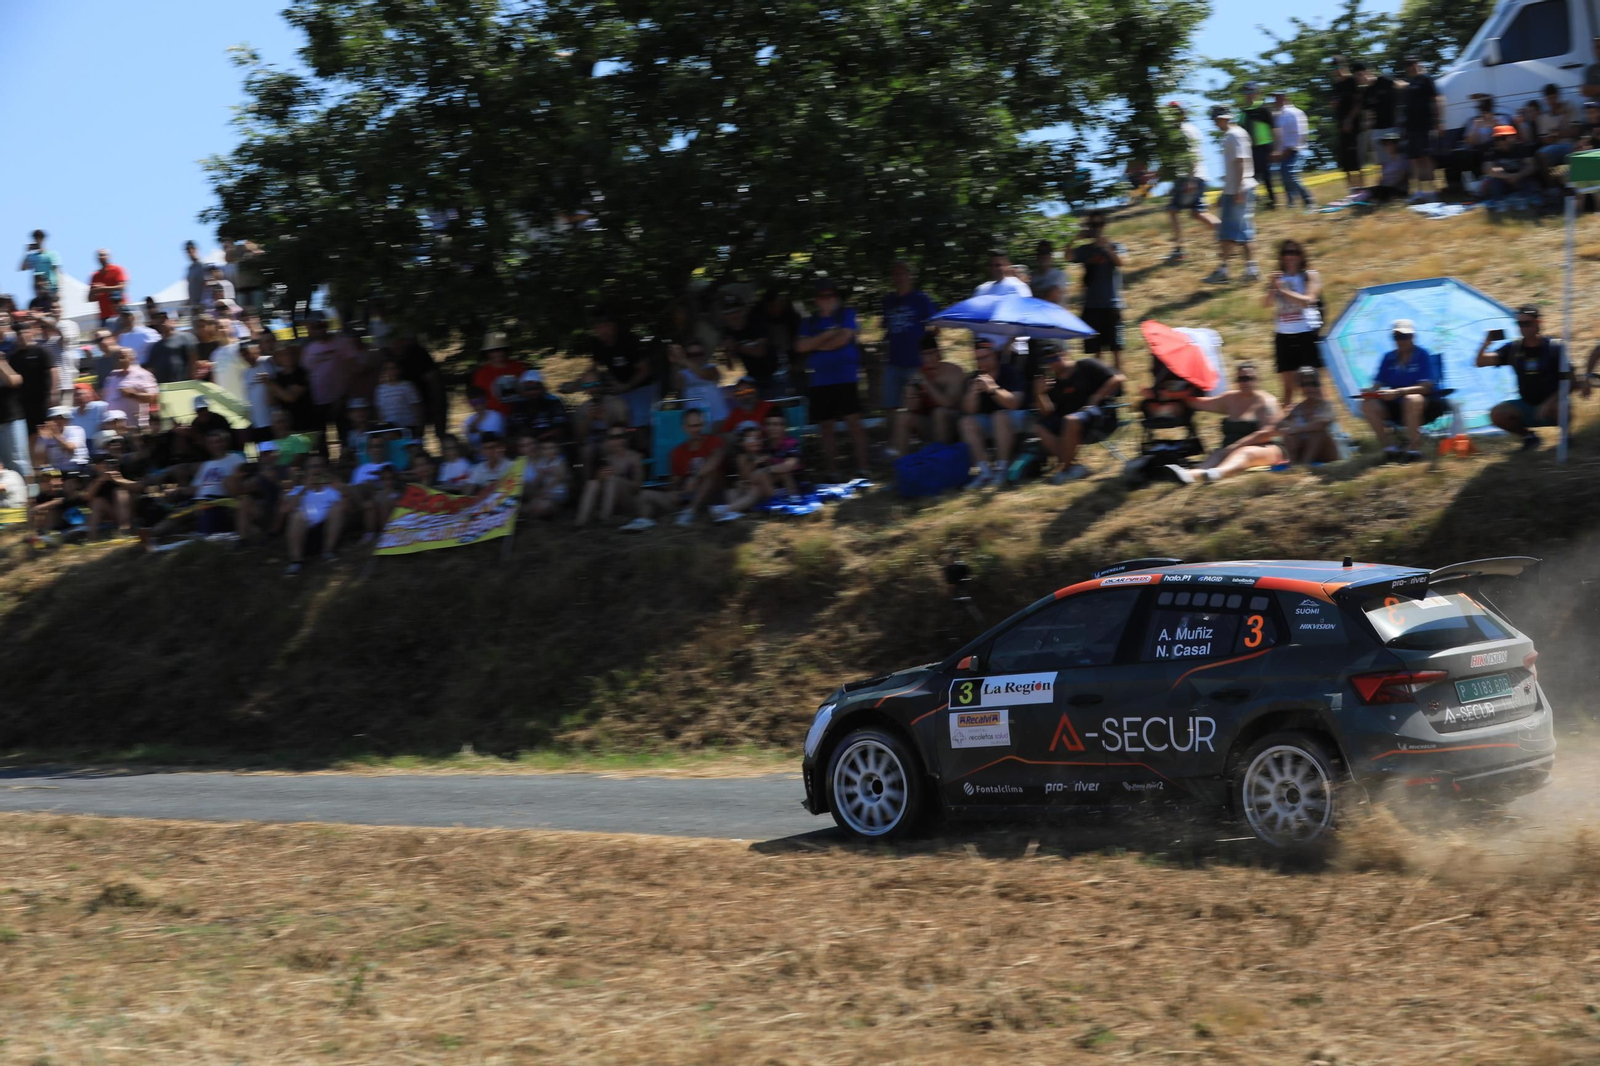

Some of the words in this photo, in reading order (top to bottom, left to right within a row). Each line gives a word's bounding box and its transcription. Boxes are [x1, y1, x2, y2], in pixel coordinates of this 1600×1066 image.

[1163, 574, 1192, 582] halo.P1
[1202, 575, 1224, 583] PAGID
[1384, 596, 1406, 626] 3
[1158, 628, 1172, 642] A.
[1175, 626, 1214, 641] Muñiz
[1244, 614, 1265, 648] 3
[1156, 645, 1170, 658] N.
[1173, 642, 1211, 657] Casal
[1470, 650, 1508, 668] HIKVISION
[958, 681, 974, 705] 3
[984, 683, 1002, 695] La
[1460, 684, 1466, 699] P
[1471, 680, 1493, 697] 3183
[965, 714, 991, 725] Recalvi
[968, 733, 994, 741] recoletas
[976, 784, 1024, 794] Fontalclima
